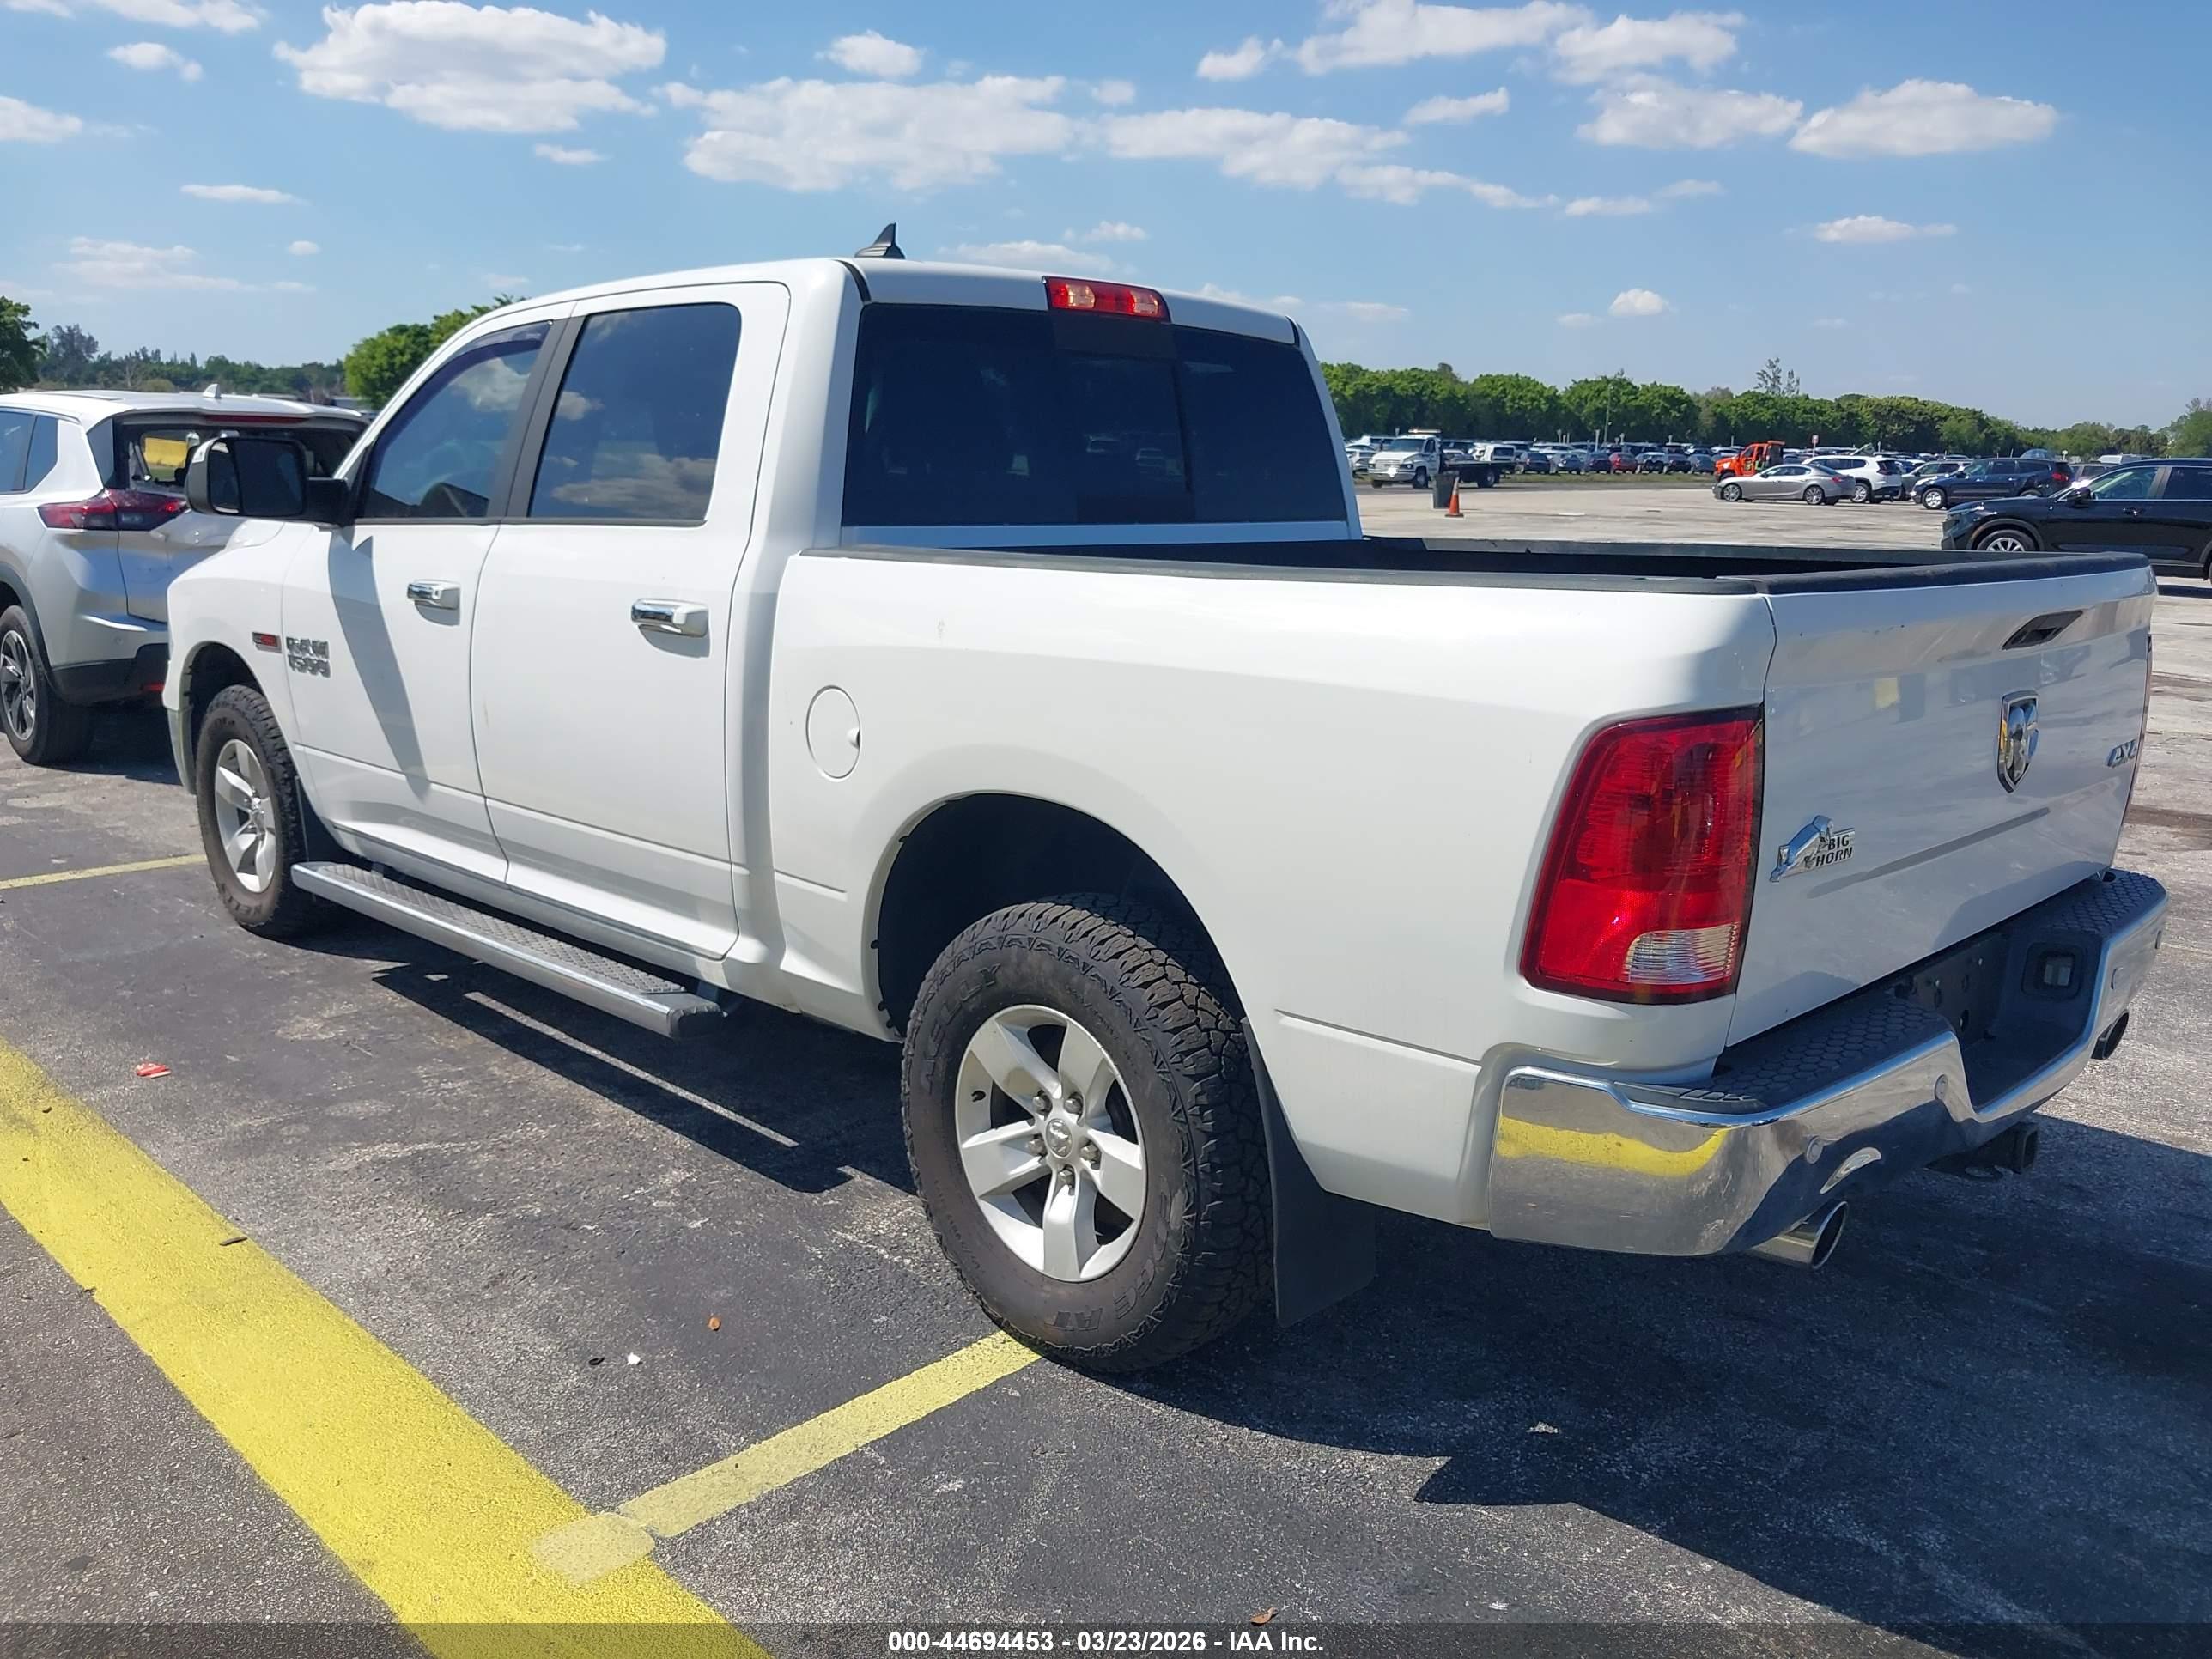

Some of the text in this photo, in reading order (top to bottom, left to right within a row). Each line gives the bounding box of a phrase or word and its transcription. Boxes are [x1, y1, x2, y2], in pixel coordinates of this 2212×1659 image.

[286, 636, 330, 659] RAM
[1827, 834, 1850, 851] BIG
[1814, 846, 1853, 867] HORN
